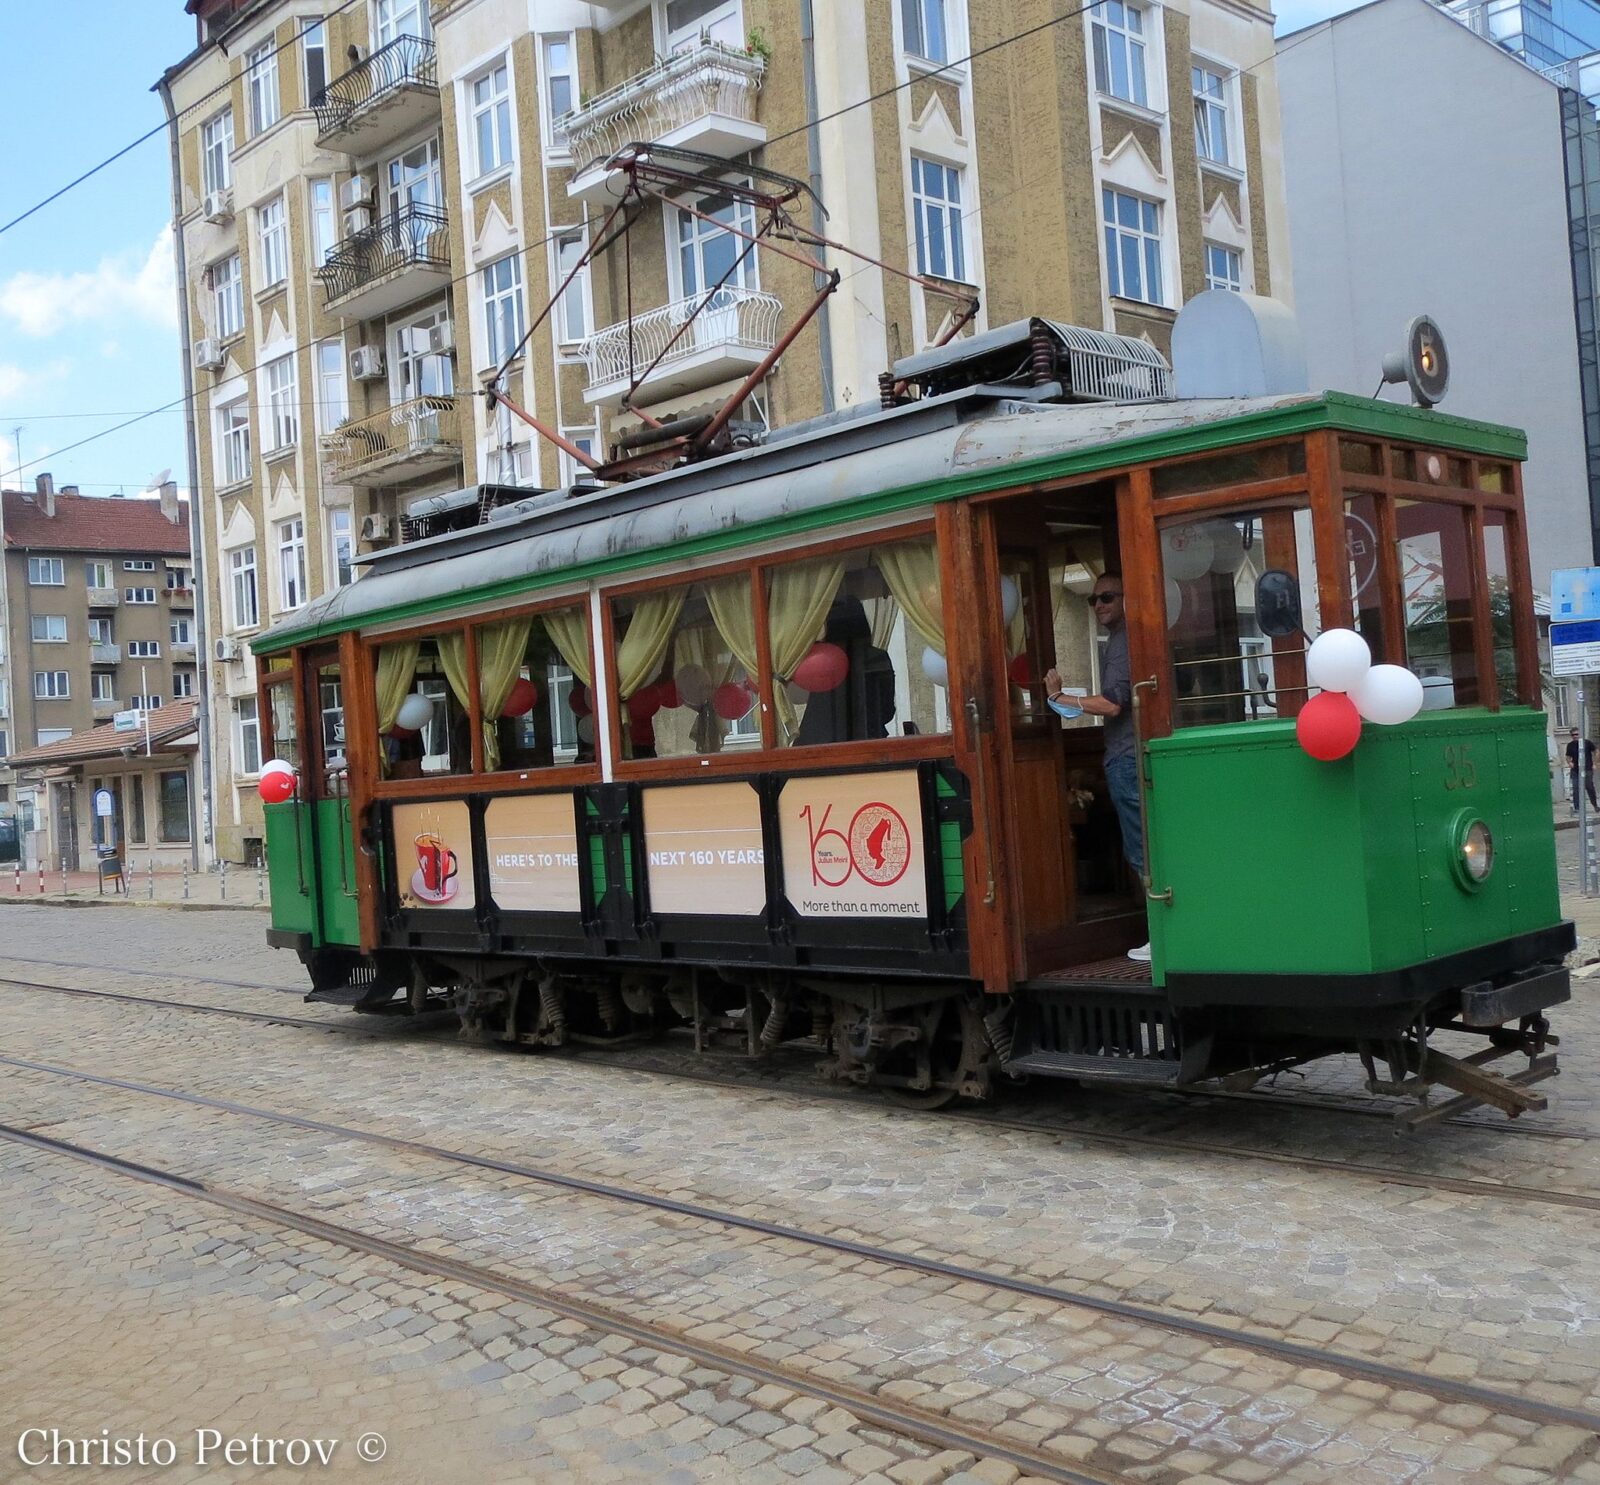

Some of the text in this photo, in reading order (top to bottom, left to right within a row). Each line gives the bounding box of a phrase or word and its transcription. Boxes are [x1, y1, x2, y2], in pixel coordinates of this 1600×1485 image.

[1443, 744, 1477, 790] 35
[799, 801, 911, 888] 160
[496, 853, 578, 867] HERE'S TO THE
[650, 849, 764, 866] NEXT 160 YEARS
[802, 901, 920, 913] More than a moment
